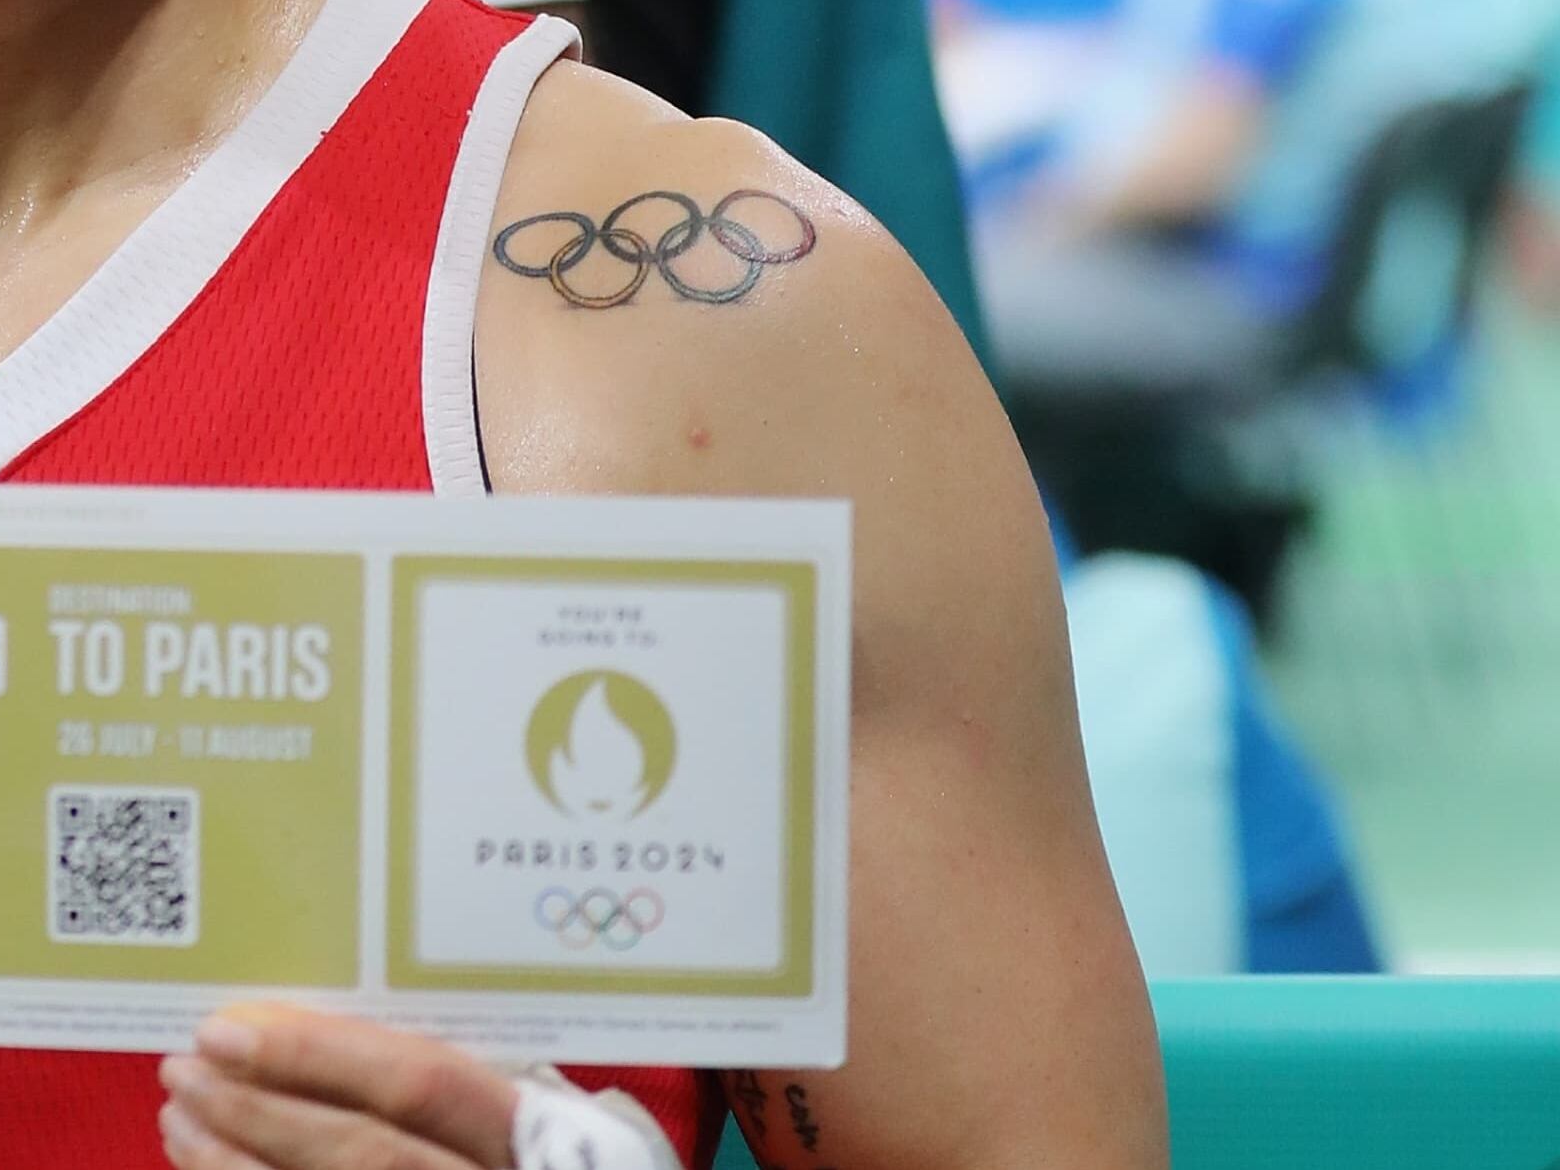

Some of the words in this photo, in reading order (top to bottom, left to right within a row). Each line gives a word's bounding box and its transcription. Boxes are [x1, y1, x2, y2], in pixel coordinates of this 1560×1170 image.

[47, 620, 126, 699] TO
[144, 622, 332, 703] PARIS
[98, 723, 159, 758] JULY
[205, 723, 314, 763] AUGUST
[475, 838, 597, 870] PARIS
[613, 841, 726, 873] 2024
